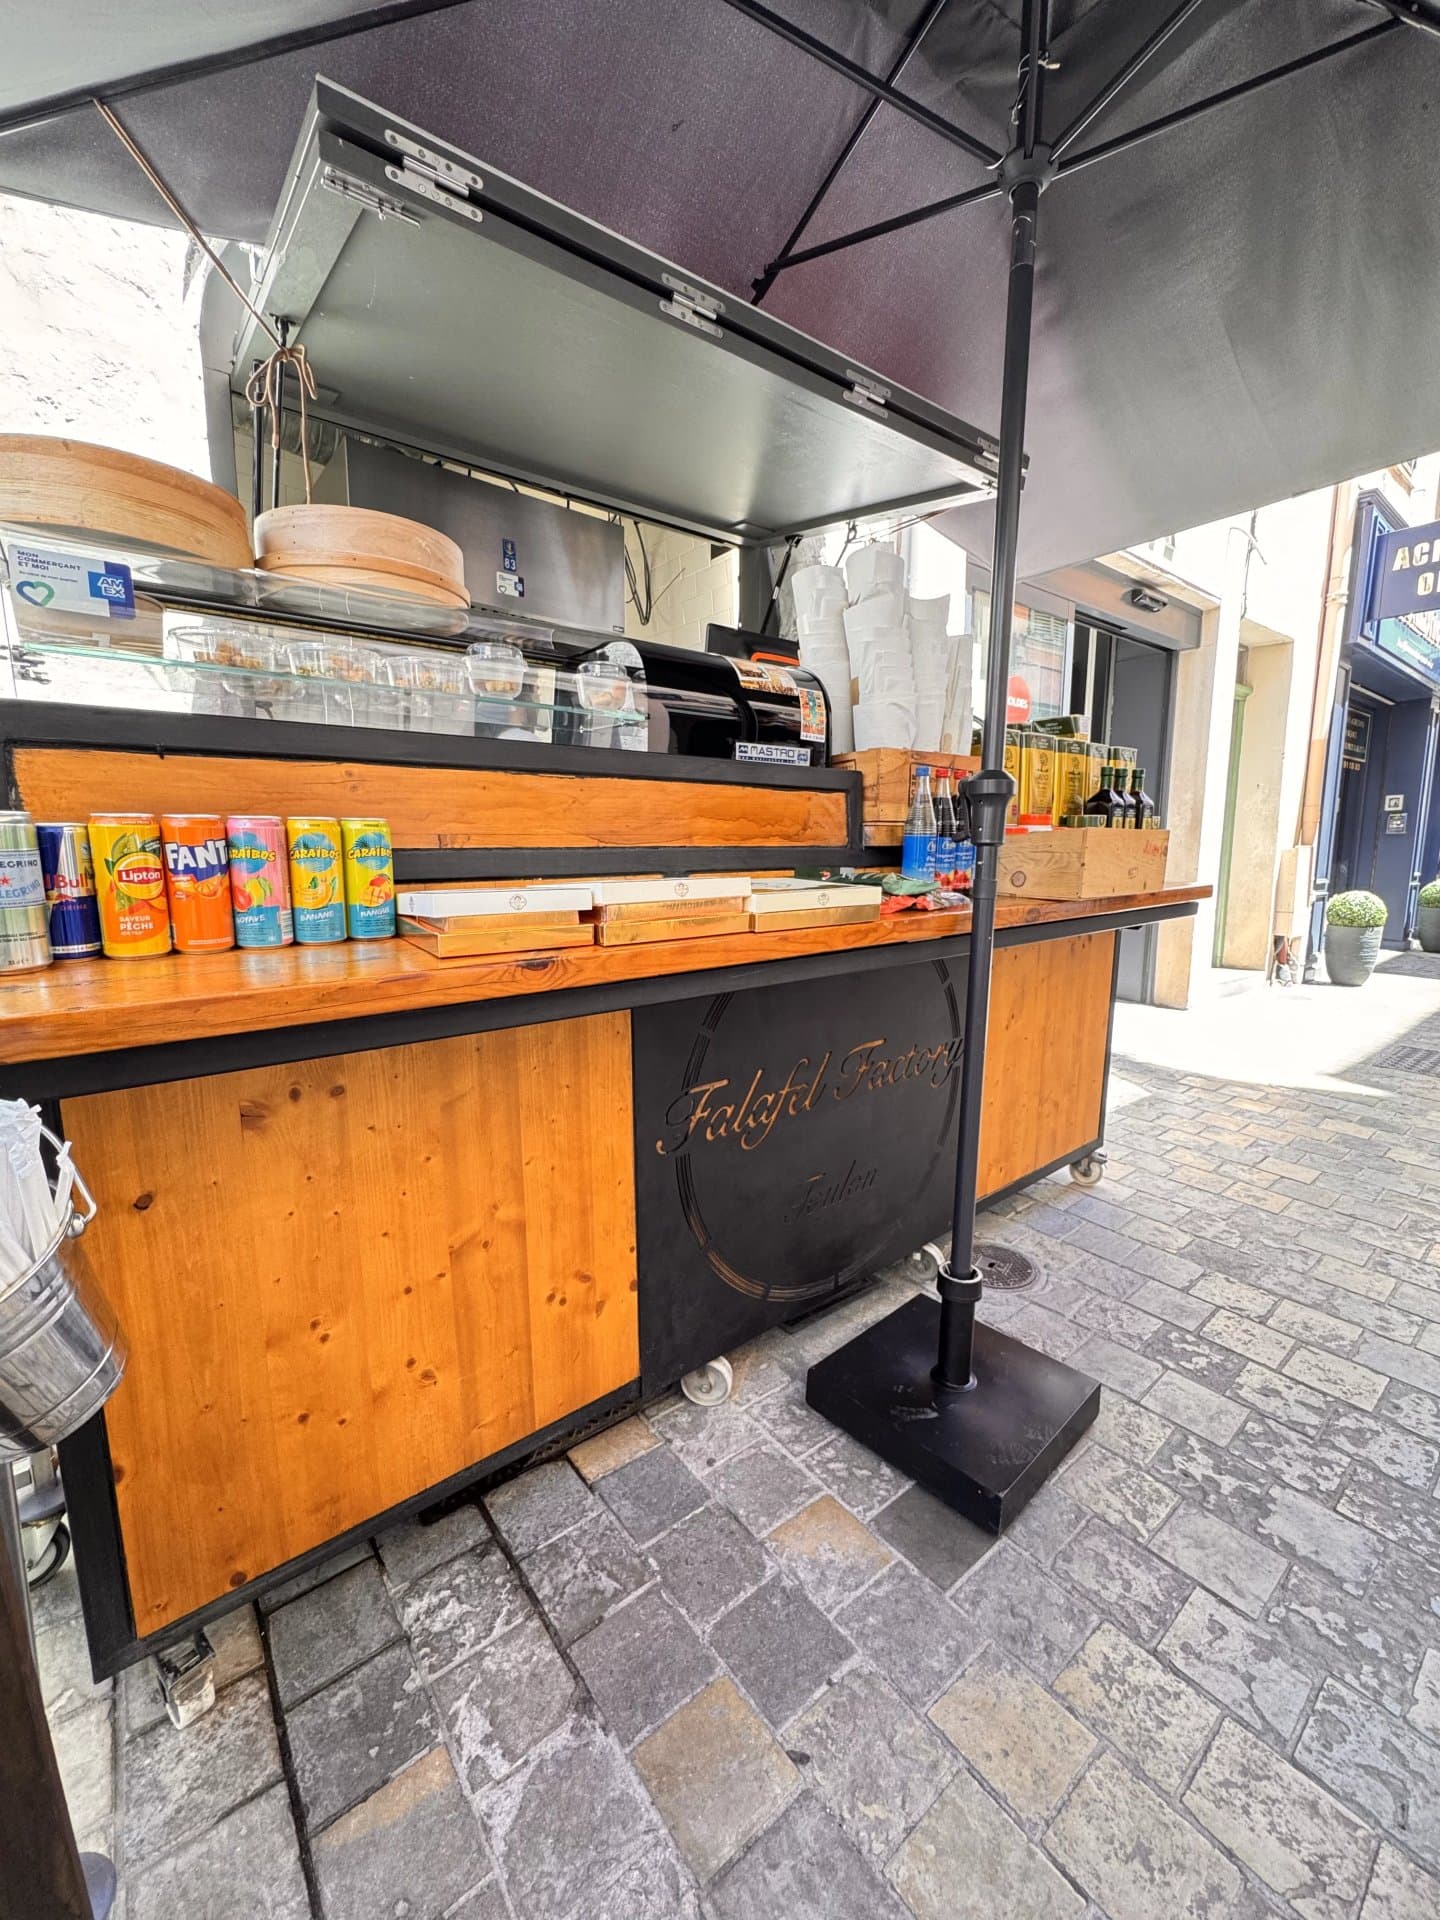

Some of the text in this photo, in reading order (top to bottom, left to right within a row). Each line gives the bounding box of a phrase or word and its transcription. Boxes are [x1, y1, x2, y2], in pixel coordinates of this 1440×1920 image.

[17, 550, 39, 558] MON
[17, 556, 81, 571] COMMERÇANT
[750, 746, 795, 758] MASTRO
[165, 840, 228, 870] FANT
[55, 873, 88, 889] Bull
[121, 870, 160, 883] Lipton
[656, 1050, 830, 1155] Falafel
